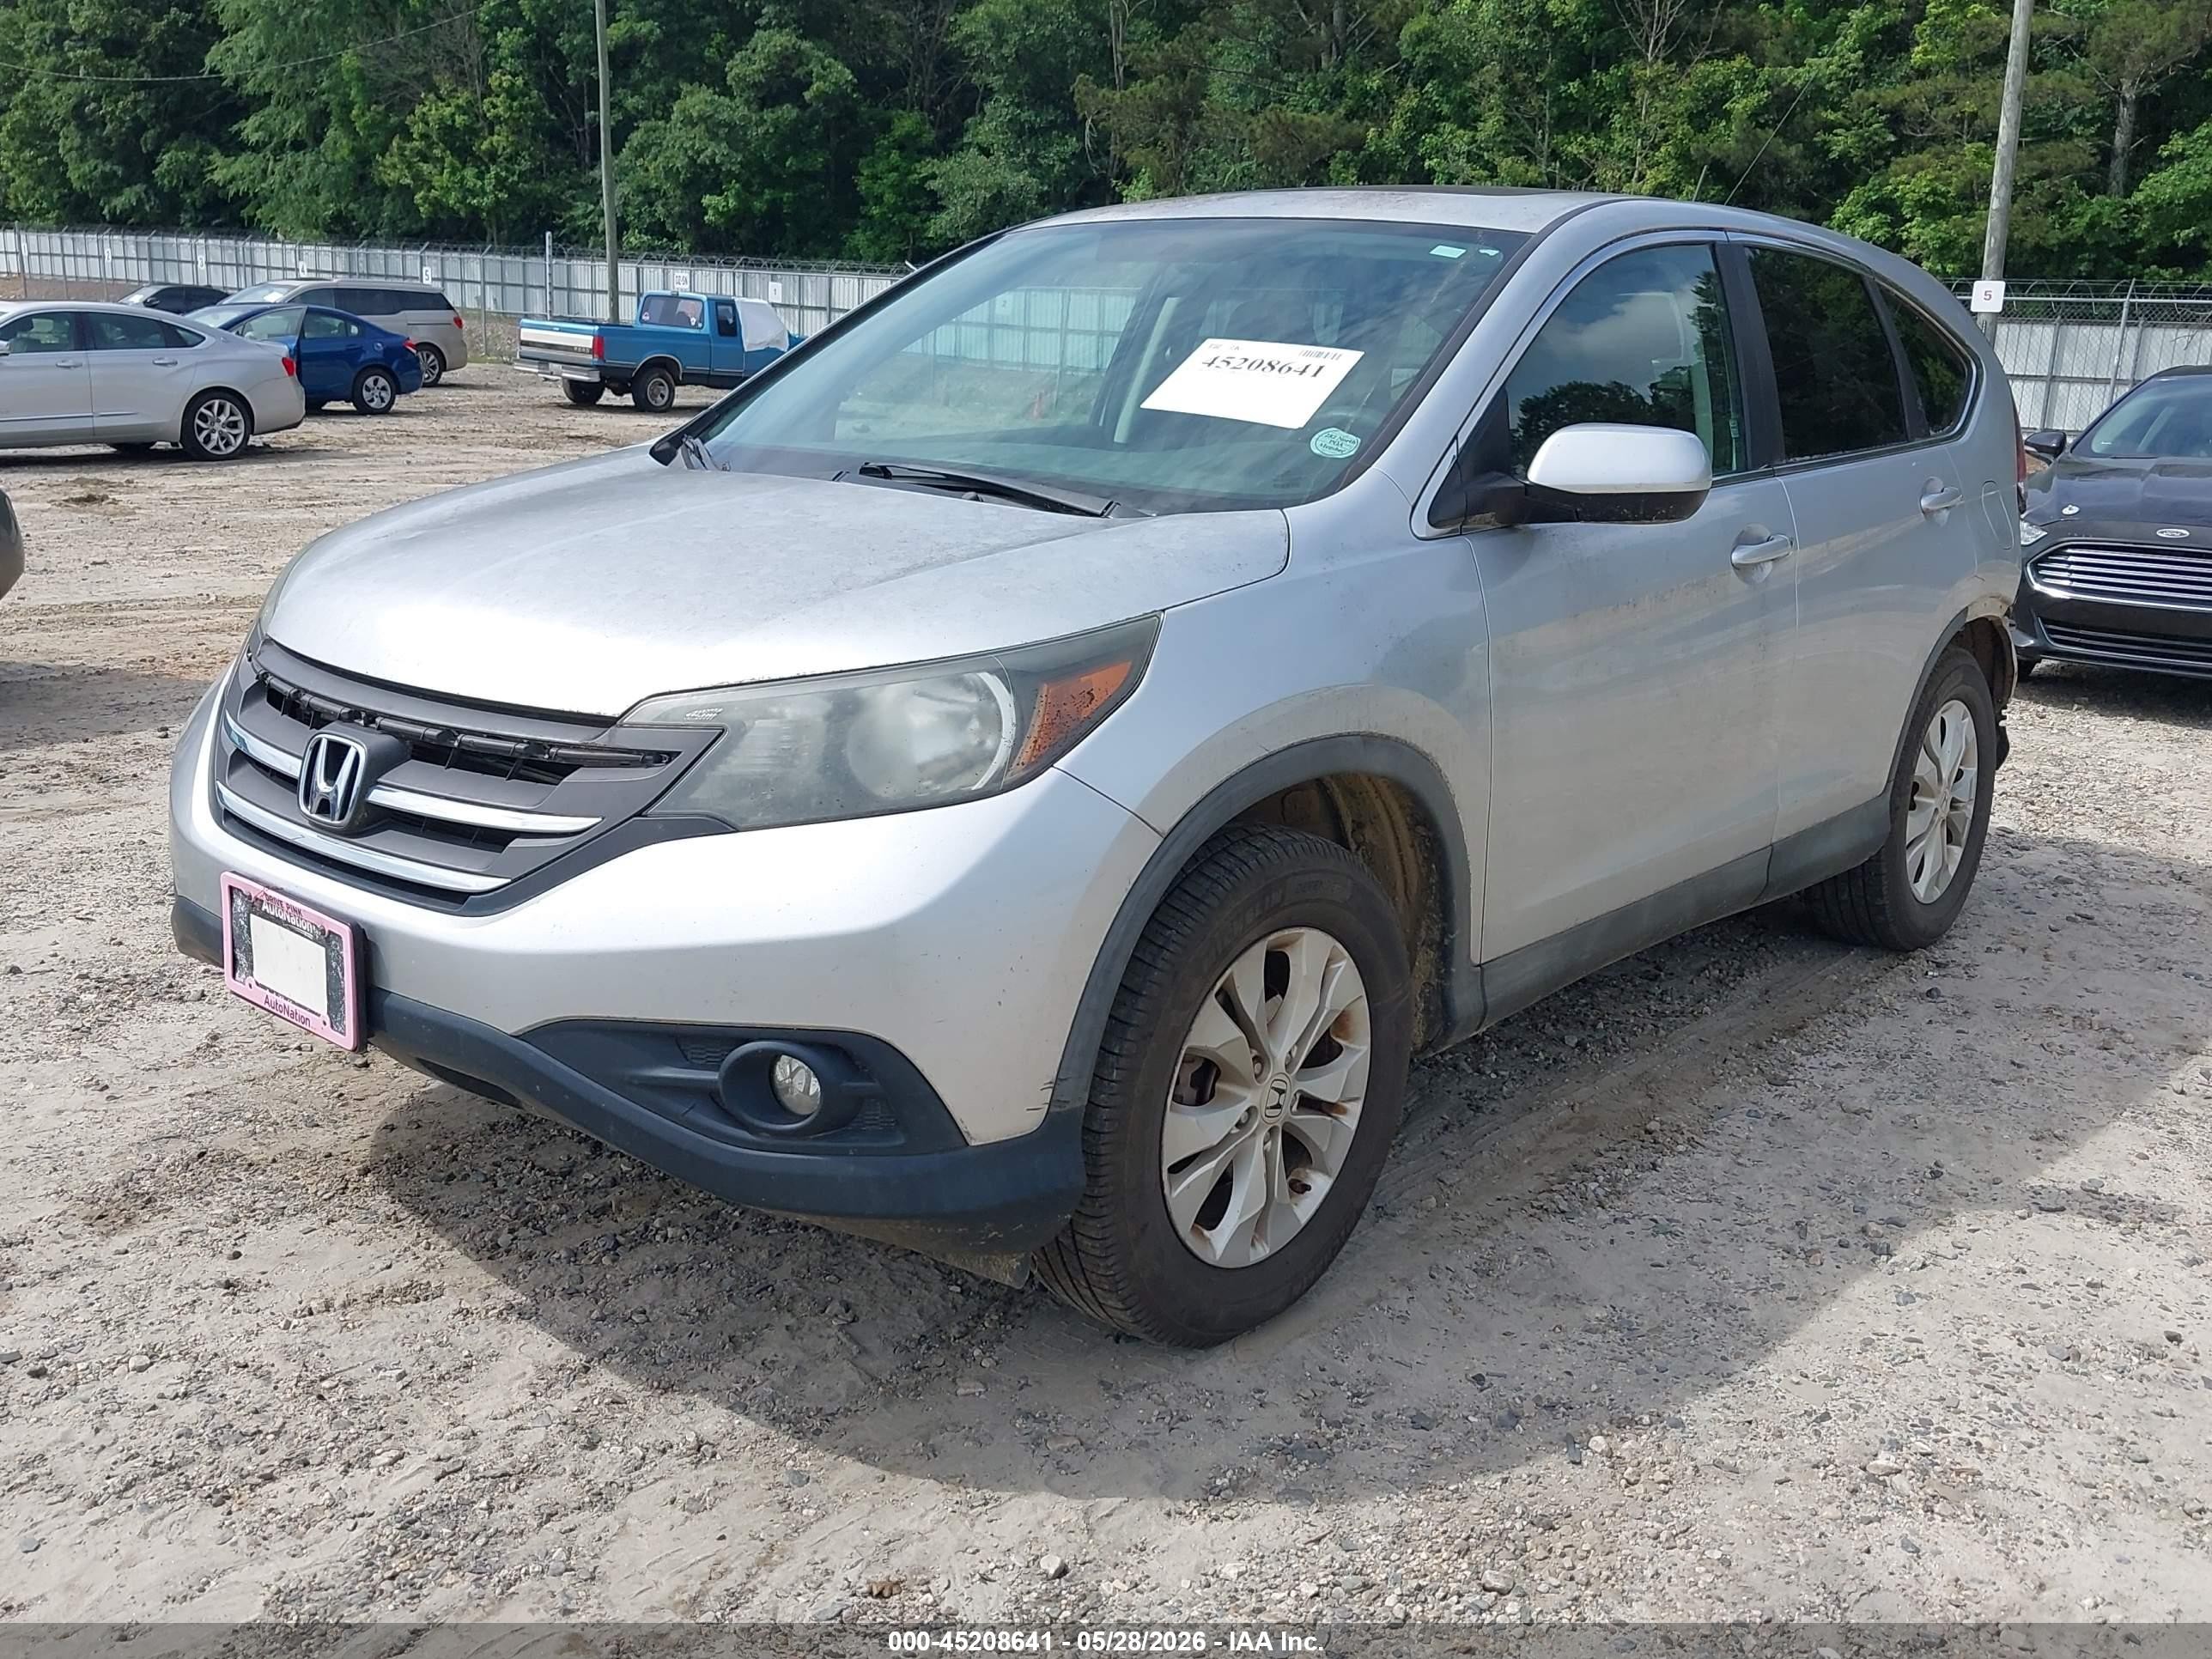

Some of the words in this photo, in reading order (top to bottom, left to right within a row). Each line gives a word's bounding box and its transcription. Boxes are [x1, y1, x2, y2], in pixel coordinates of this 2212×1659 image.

[424, 270, 429, 281] 5
[1984, 290, 1992, 301] 5
[1201, 355, 1326, 378] 45208641
[261, 899, 313, 934] AutoNation
[265, 894, 284, 908] DRIVE
[286, 902, 303, 917] PINK
[264, 994, 311, 1028] AutoNation
